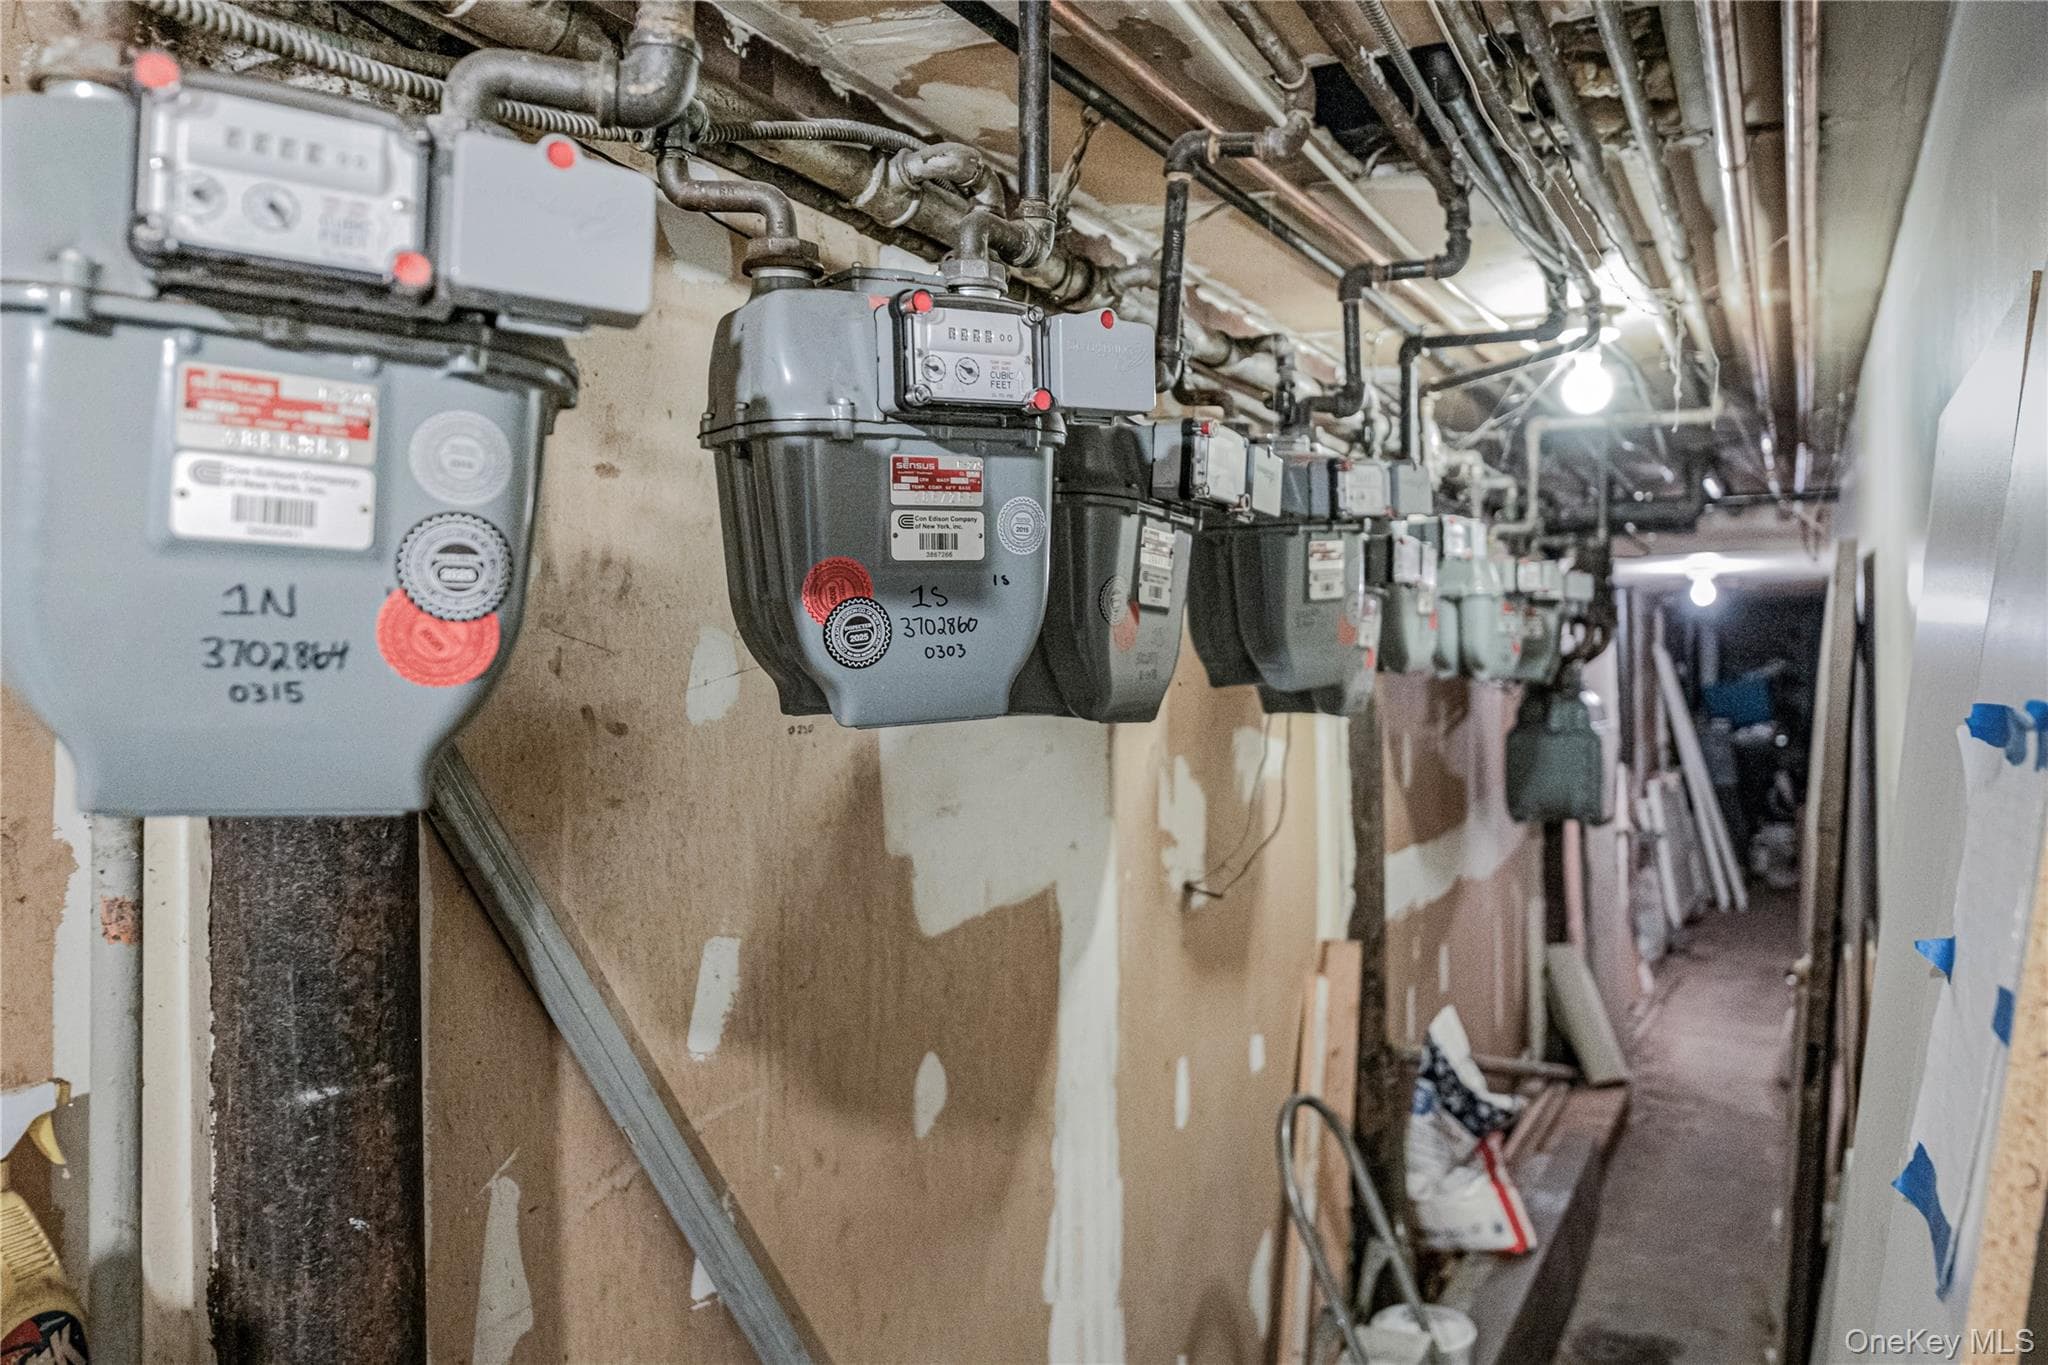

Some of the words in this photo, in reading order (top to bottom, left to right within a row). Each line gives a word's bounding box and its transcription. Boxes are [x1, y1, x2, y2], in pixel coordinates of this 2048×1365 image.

[990, 370, 1014, 380] CUBIC
[990, 380, 1012, 390] FEET
[950, 516, 978, 524] Company
[219, 583, 297, 618] 1N
[910, 584, 949, 608] 1S
[900, 616, 978, 638] 3702860
[849, 632, 869, 643] 2025
[924, 643, 966, 659] 0303
[228, 679, 305, 703] 0315
